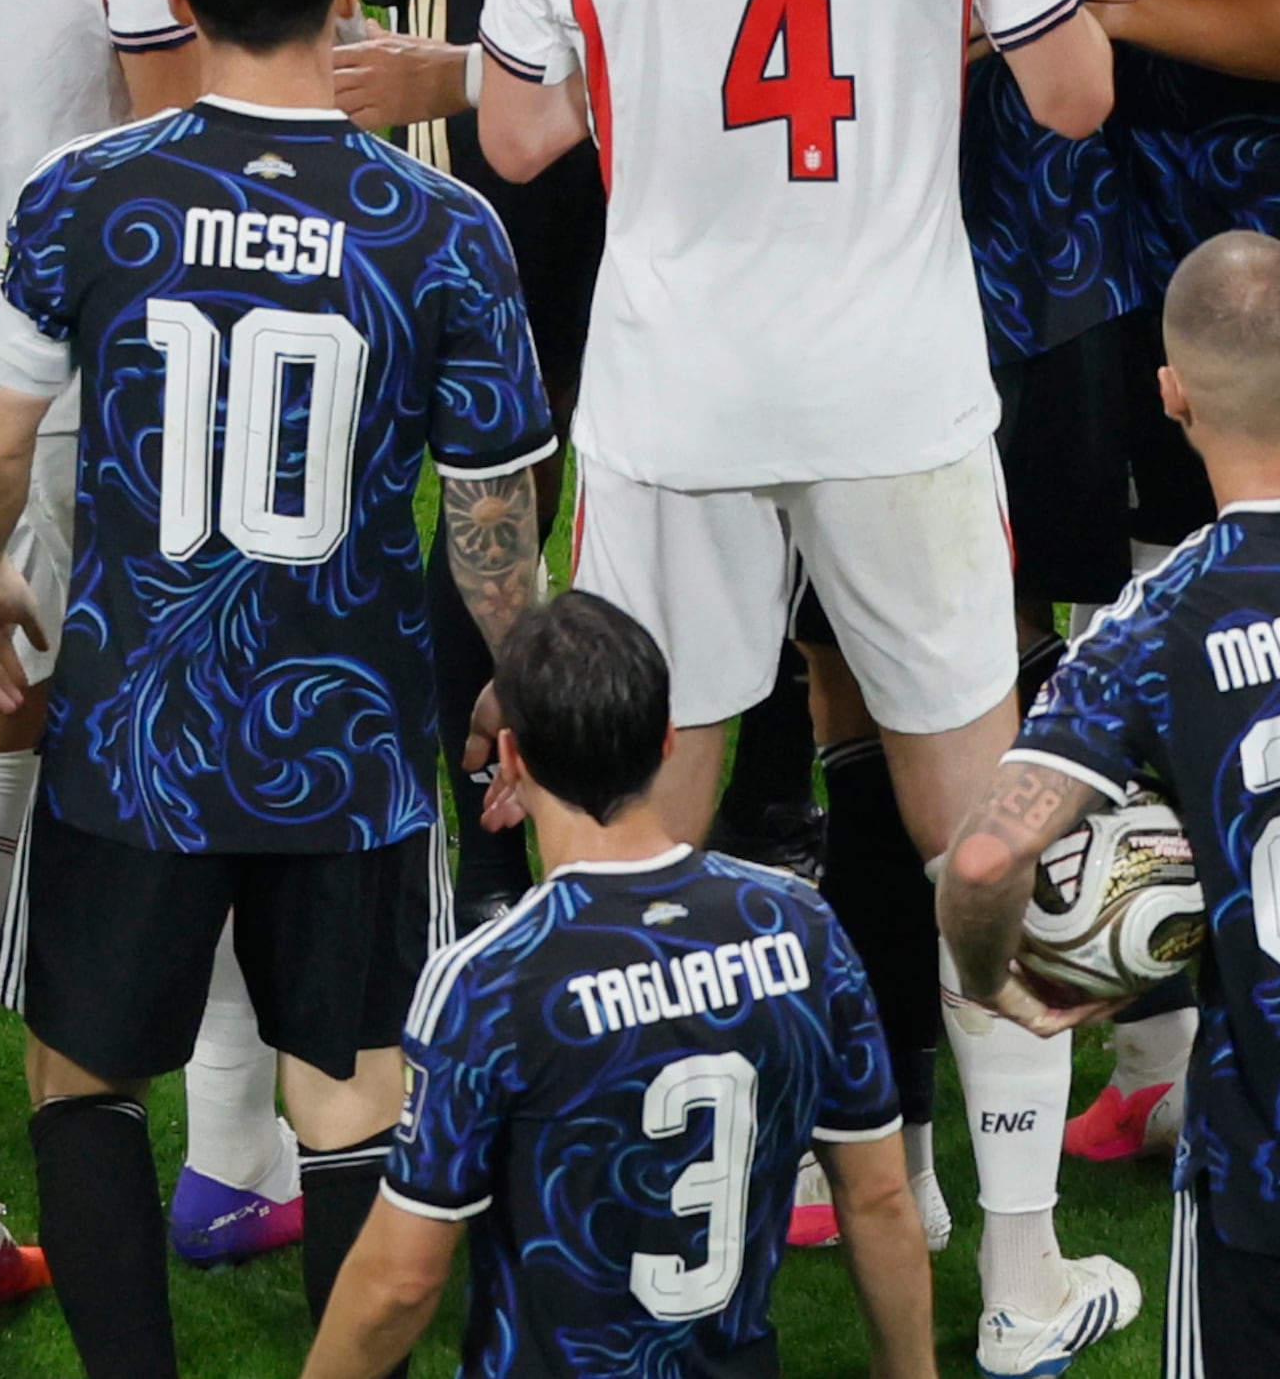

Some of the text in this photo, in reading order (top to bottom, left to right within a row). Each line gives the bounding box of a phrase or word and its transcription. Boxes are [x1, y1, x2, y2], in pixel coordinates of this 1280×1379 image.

[183, 207, 345, 278] MESSI
[146, 298, 369, 566] 10
[567, 931, 811, 1036] TAGLIAFICO
[980, 1109, 1037, 1134] ENG
[630, 1052, 758, 1321] 3
